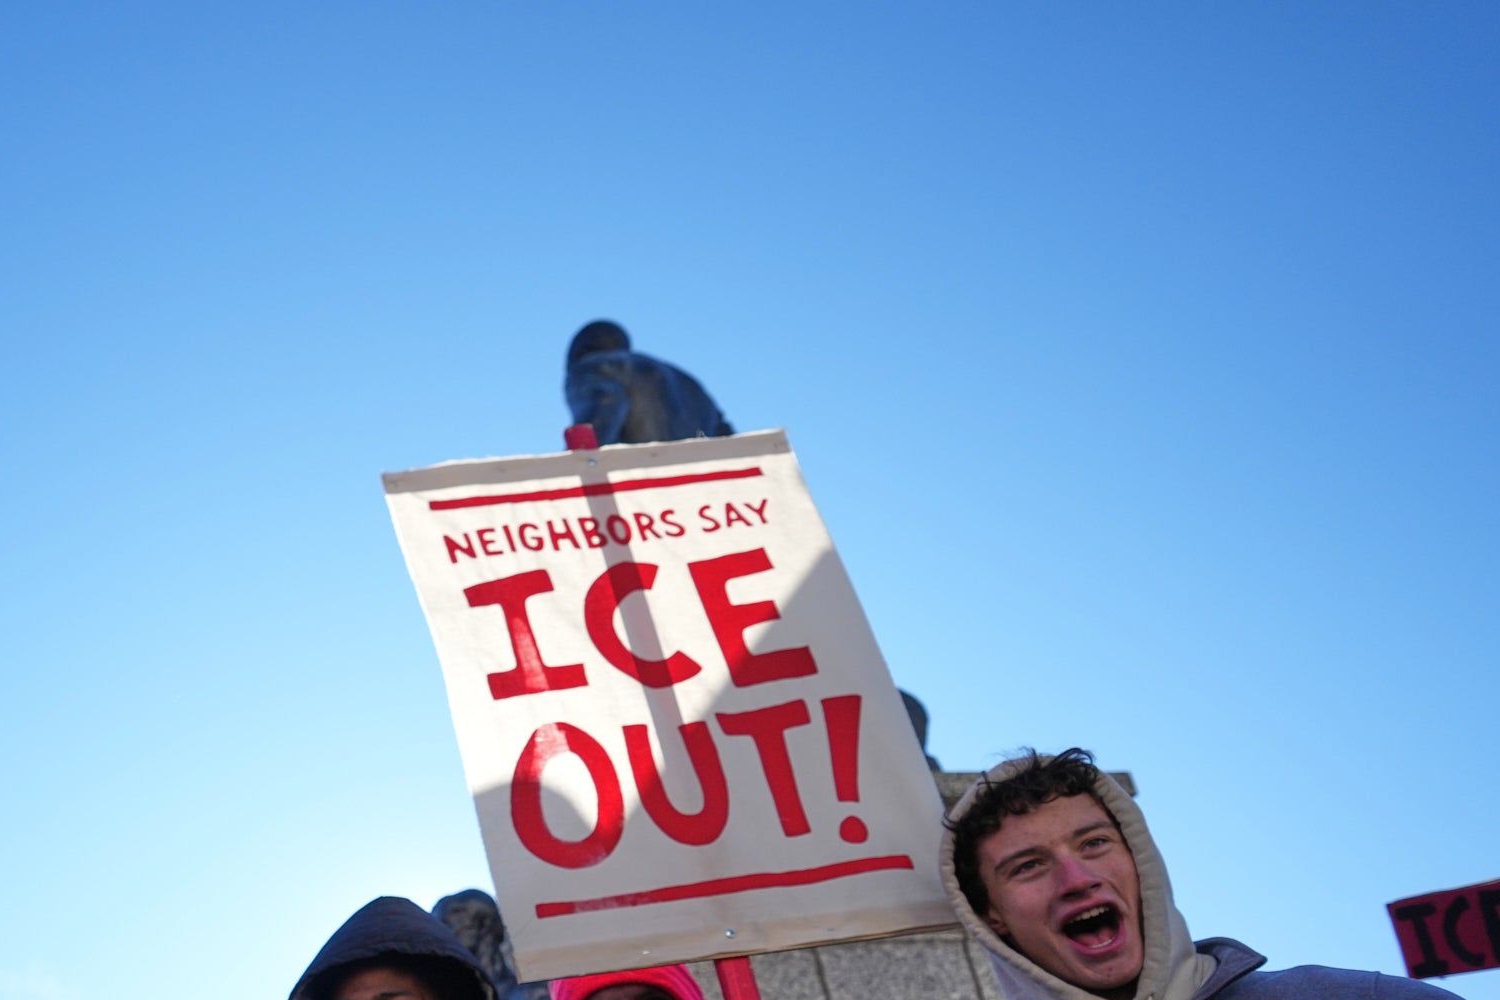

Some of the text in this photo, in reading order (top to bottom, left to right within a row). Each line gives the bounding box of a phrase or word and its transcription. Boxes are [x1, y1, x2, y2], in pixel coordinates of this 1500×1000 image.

[442, 498, 770, 563] NEIGHBORS SAY
[462, 546, 819, 700] ICE
[509, 693, 869, 869] OUT!
